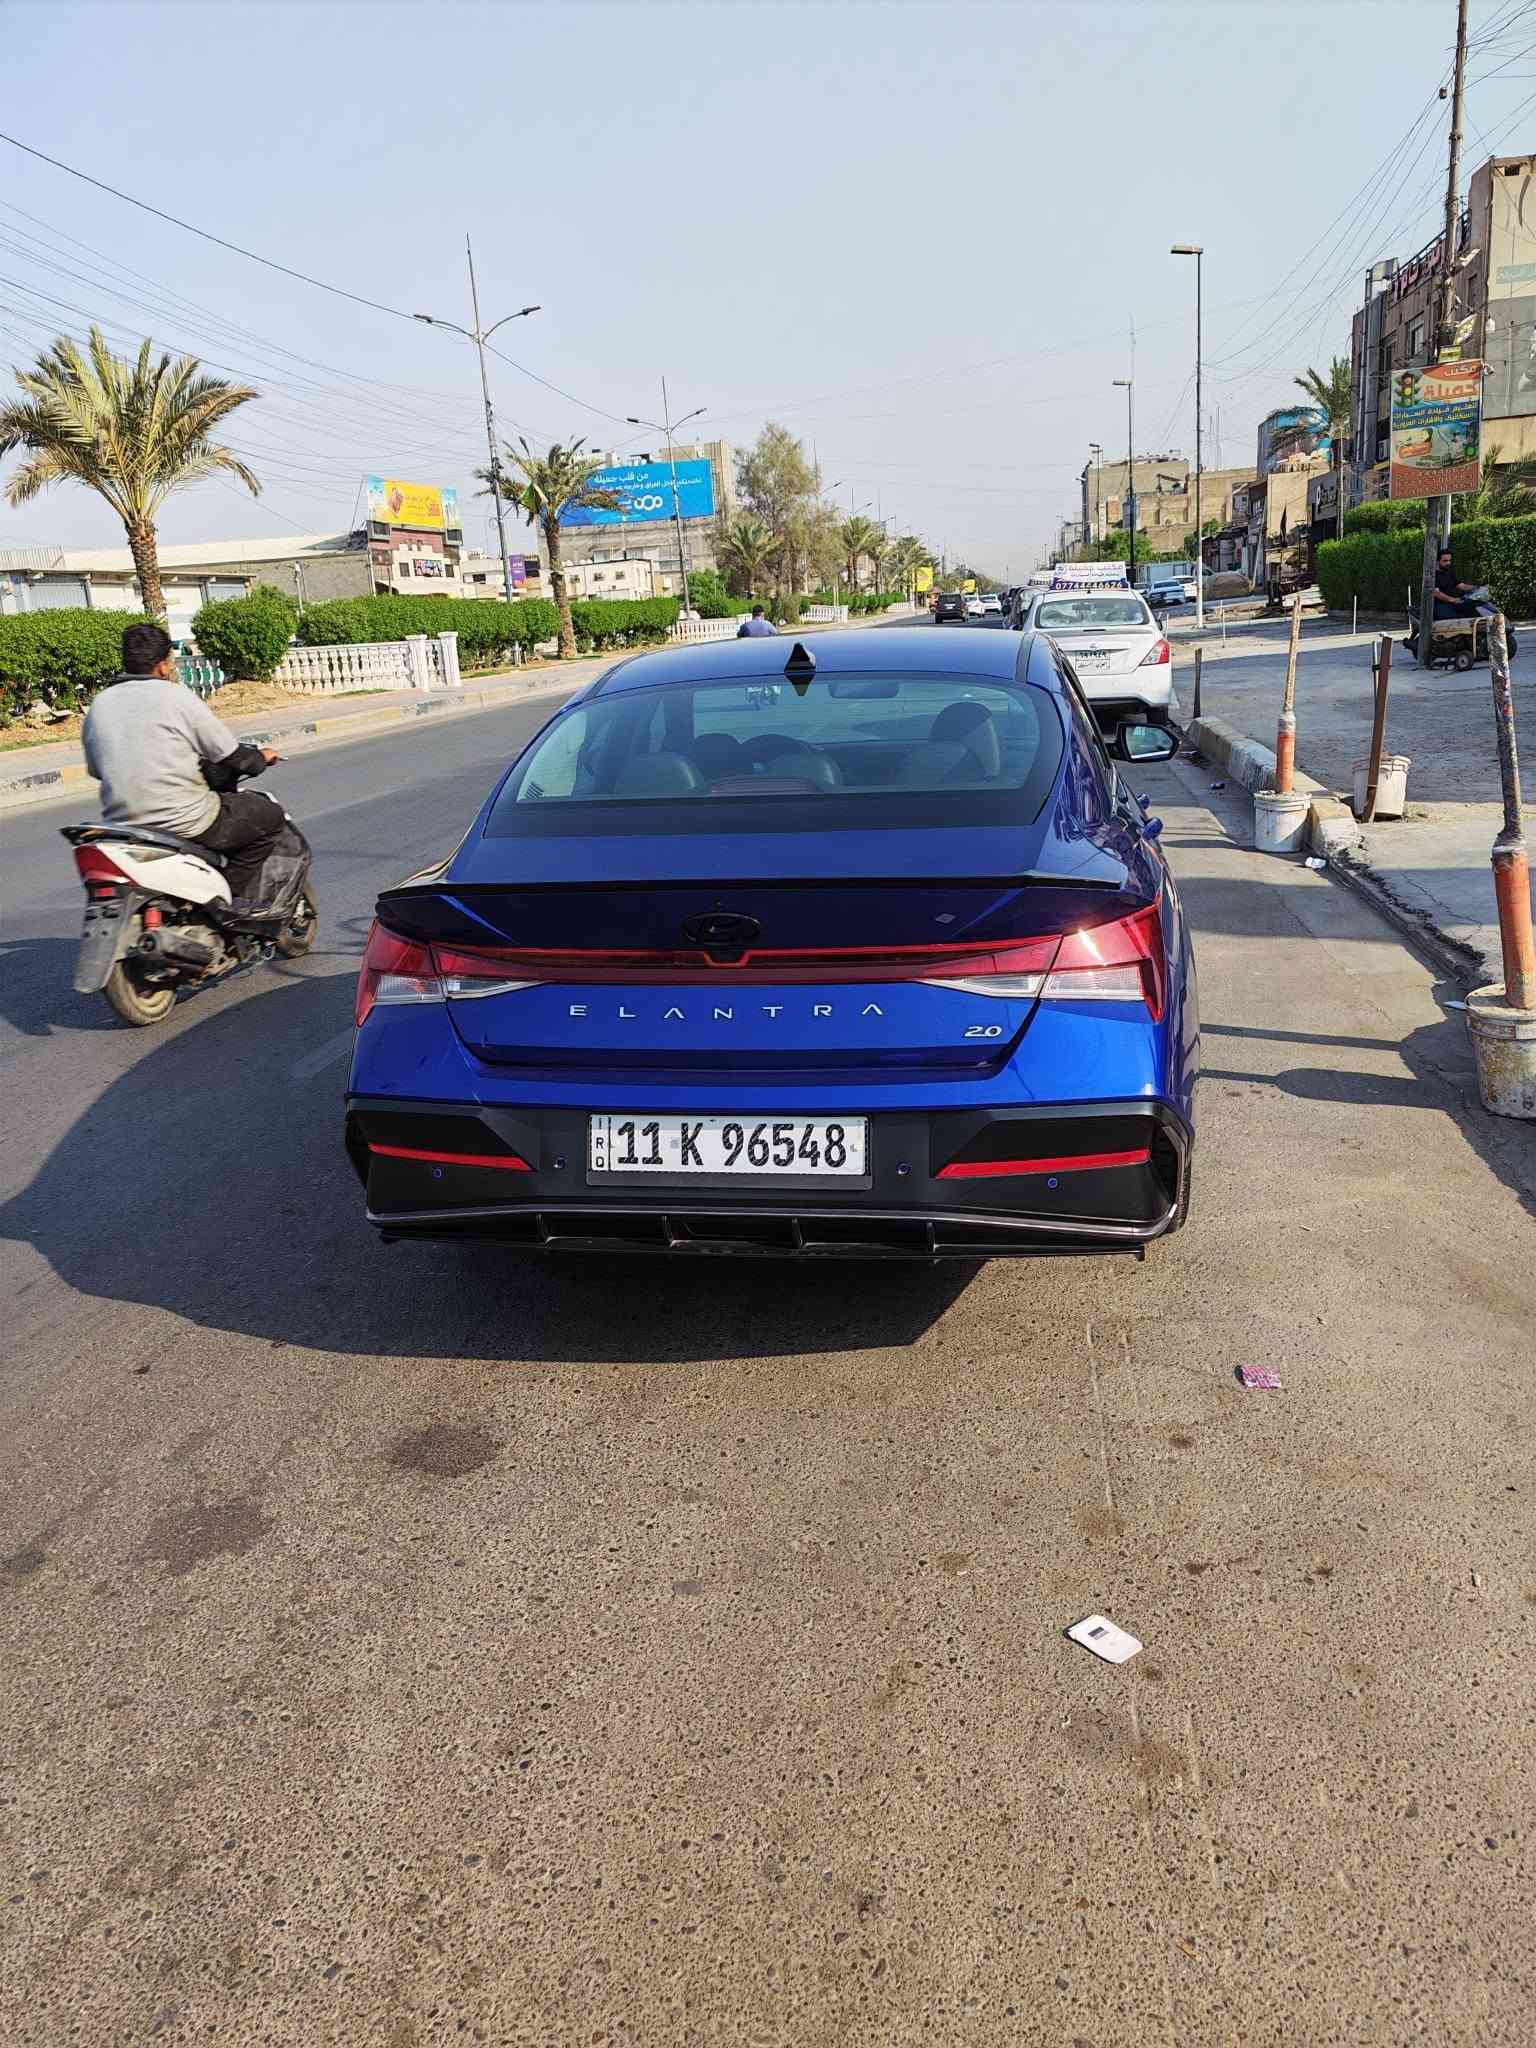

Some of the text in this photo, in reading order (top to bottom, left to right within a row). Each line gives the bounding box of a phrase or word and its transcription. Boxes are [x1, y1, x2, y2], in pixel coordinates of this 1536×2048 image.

[636, 473, 649, 482] من
[569, 1003, 884, 1020] ELANTRA
[617, 1121, 847, 1168] 11 K 96548
